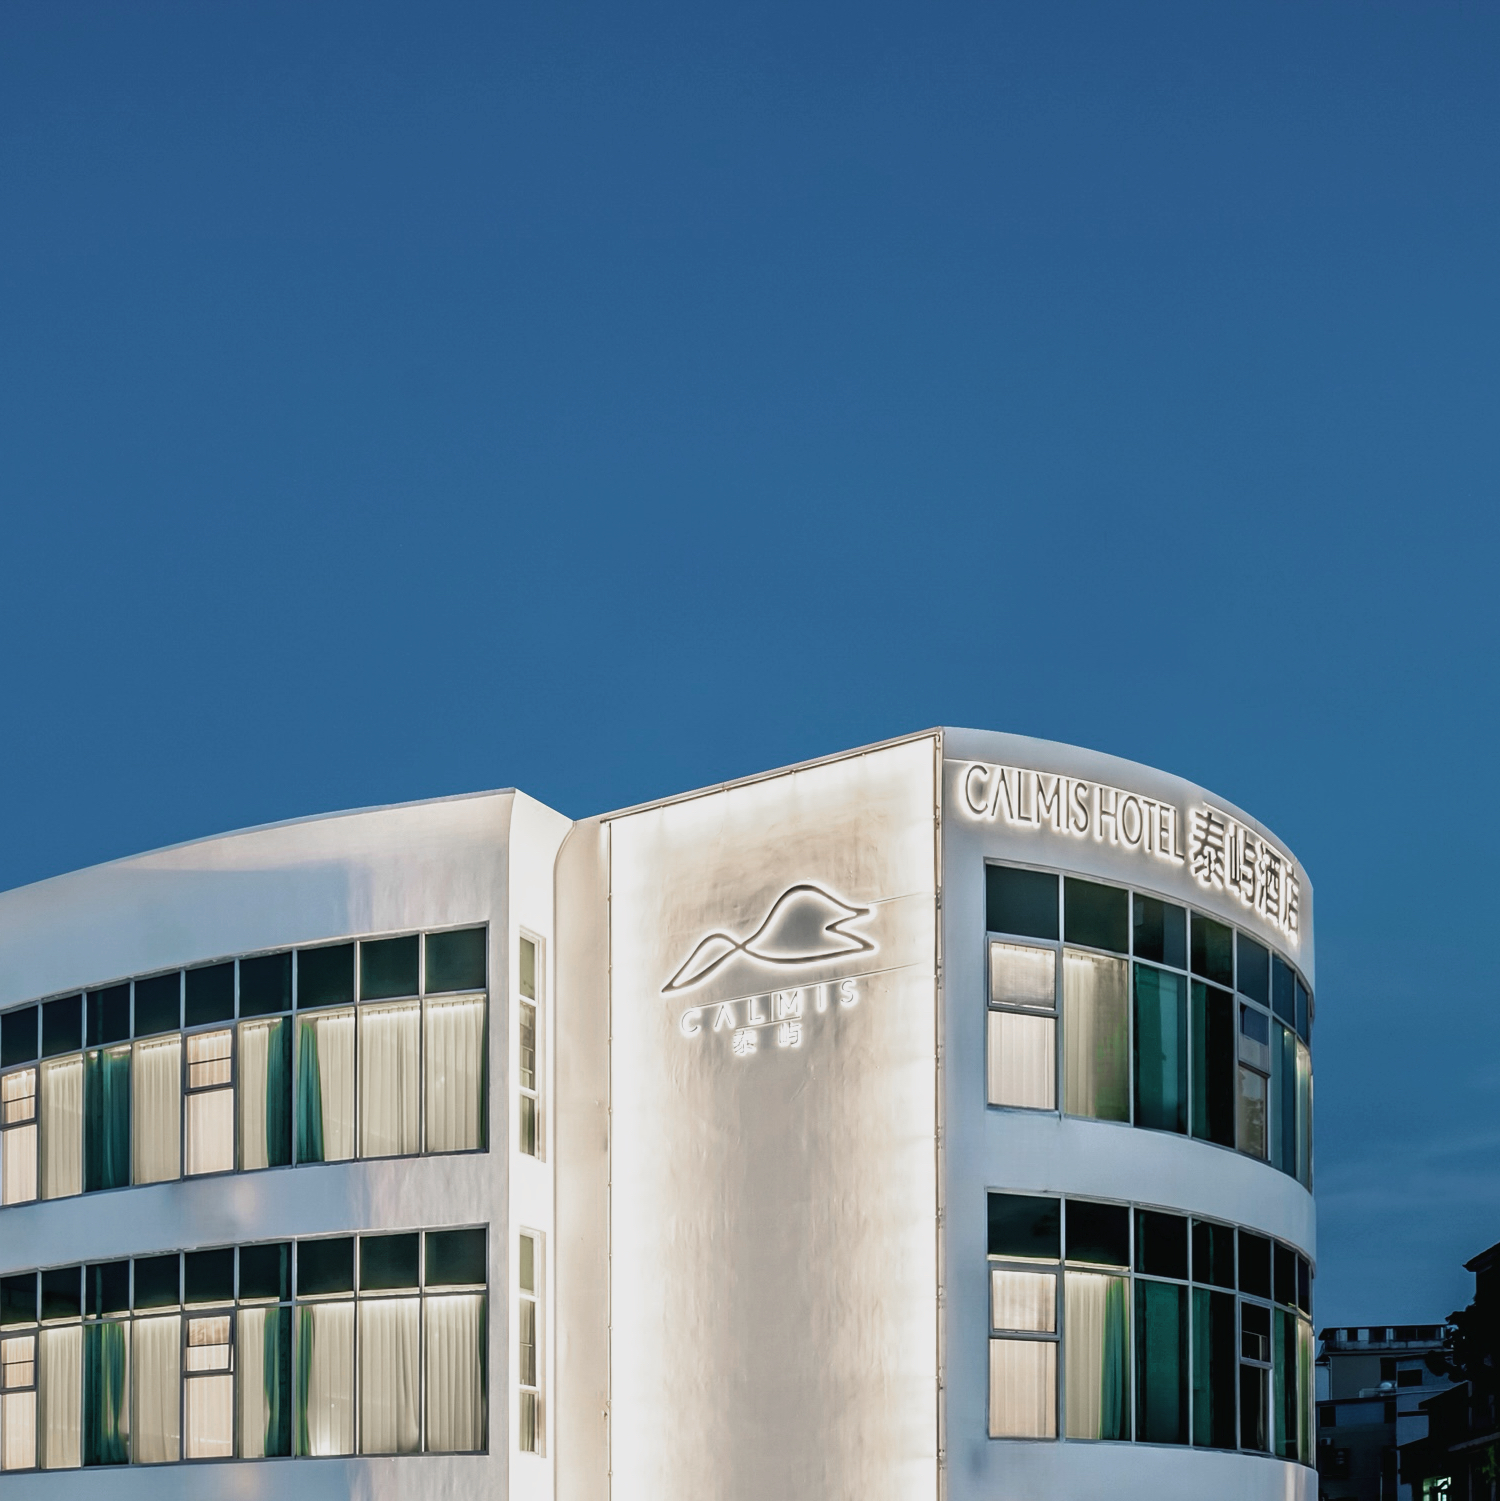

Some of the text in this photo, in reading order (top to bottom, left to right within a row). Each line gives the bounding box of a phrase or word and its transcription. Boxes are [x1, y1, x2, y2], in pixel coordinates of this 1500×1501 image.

[963, 763, 1300, 946] CALMIS HOTEL 泰屿酒店
[680, 979, 857, 1036] CALMIS
[732, 1021, 802, 1056] 泰屿
